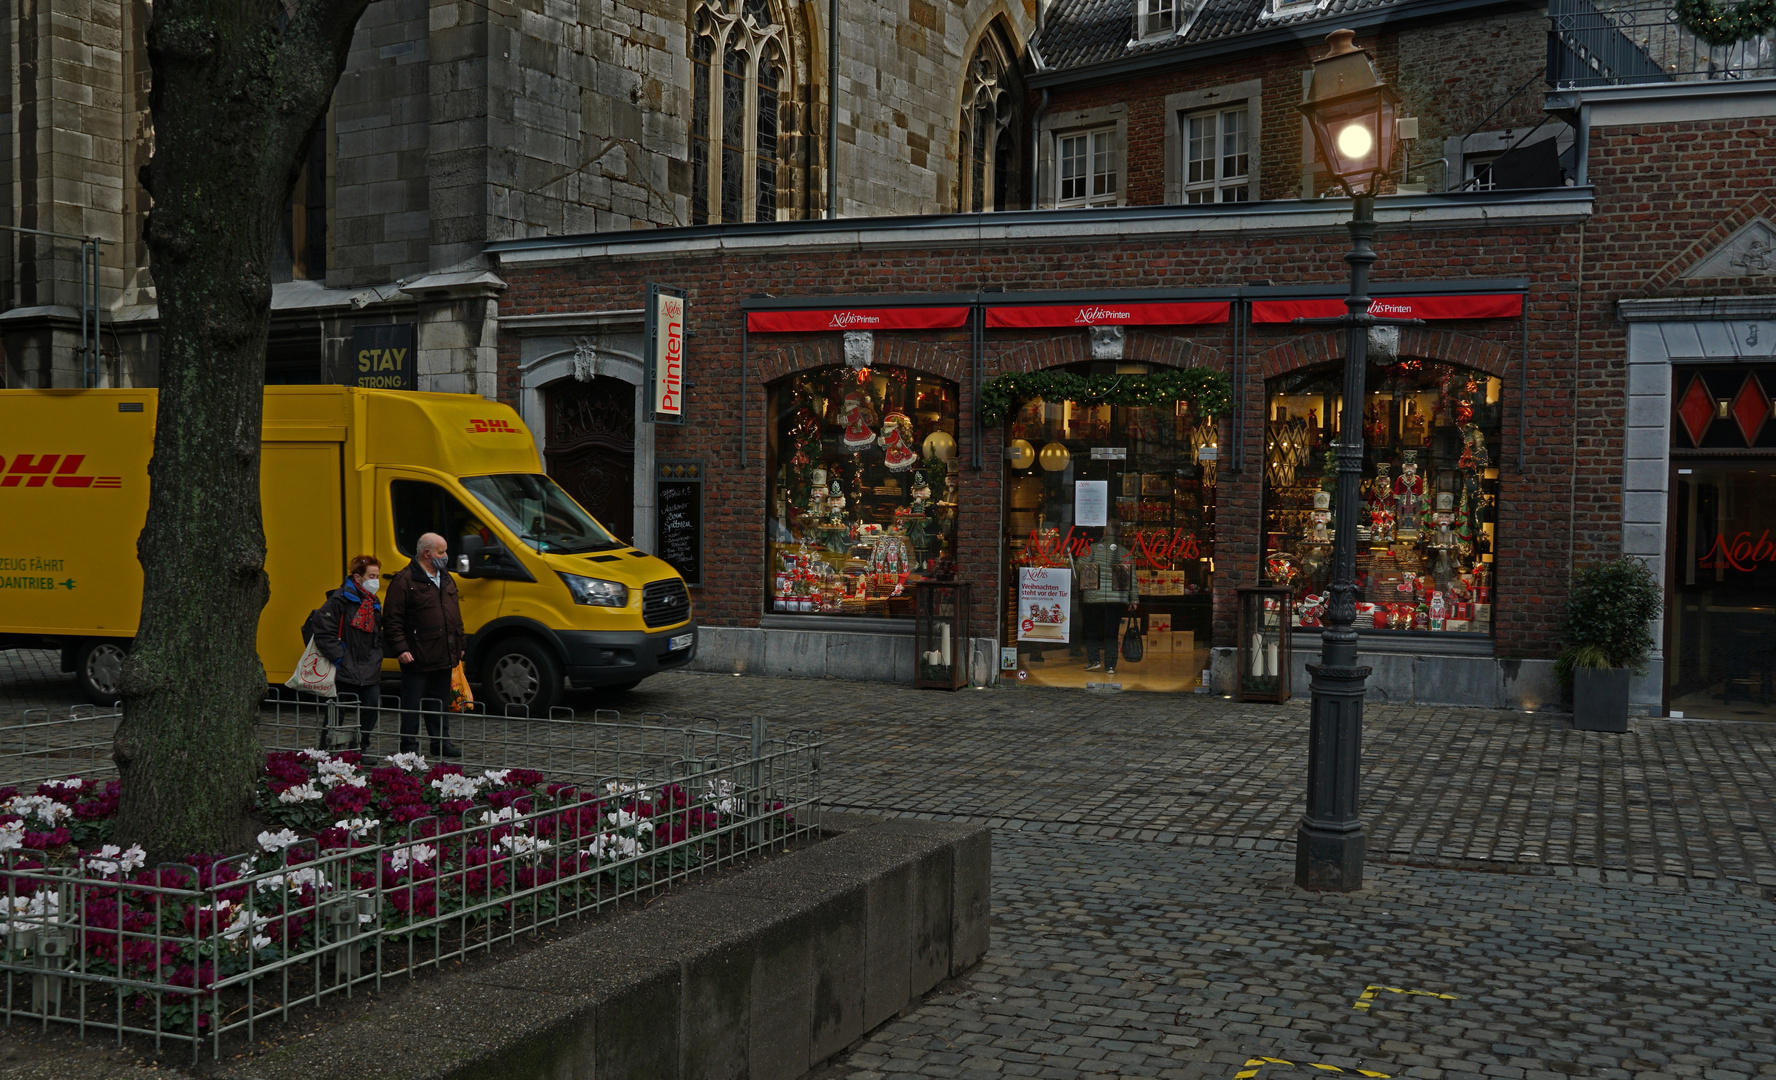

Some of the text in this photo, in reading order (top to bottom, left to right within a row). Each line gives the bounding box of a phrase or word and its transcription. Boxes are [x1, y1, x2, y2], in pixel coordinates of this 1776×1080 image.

[661, 300, 681, 318] Nobis
[1075, 306, 1130, 323] Nobis Printen
[1385, 304, 1411, 313] Printen
[828, 311, 879, 328] Nobis Printen
[358, 348, 407, 373] STAY
[662, 322, 681, 411] Printen
[470, 419, 515, 433] DHL
[0, 454, 95, 488] HL
[1018, 525, 1094, 566] Nobis
[1121, 527, 1202, 569] Nobis
[30, 556, 64, 572] FÄHRT
[1022, 568, 1048, 581] Nobis
[1022, 583, 1059, 591] Weihnachten
